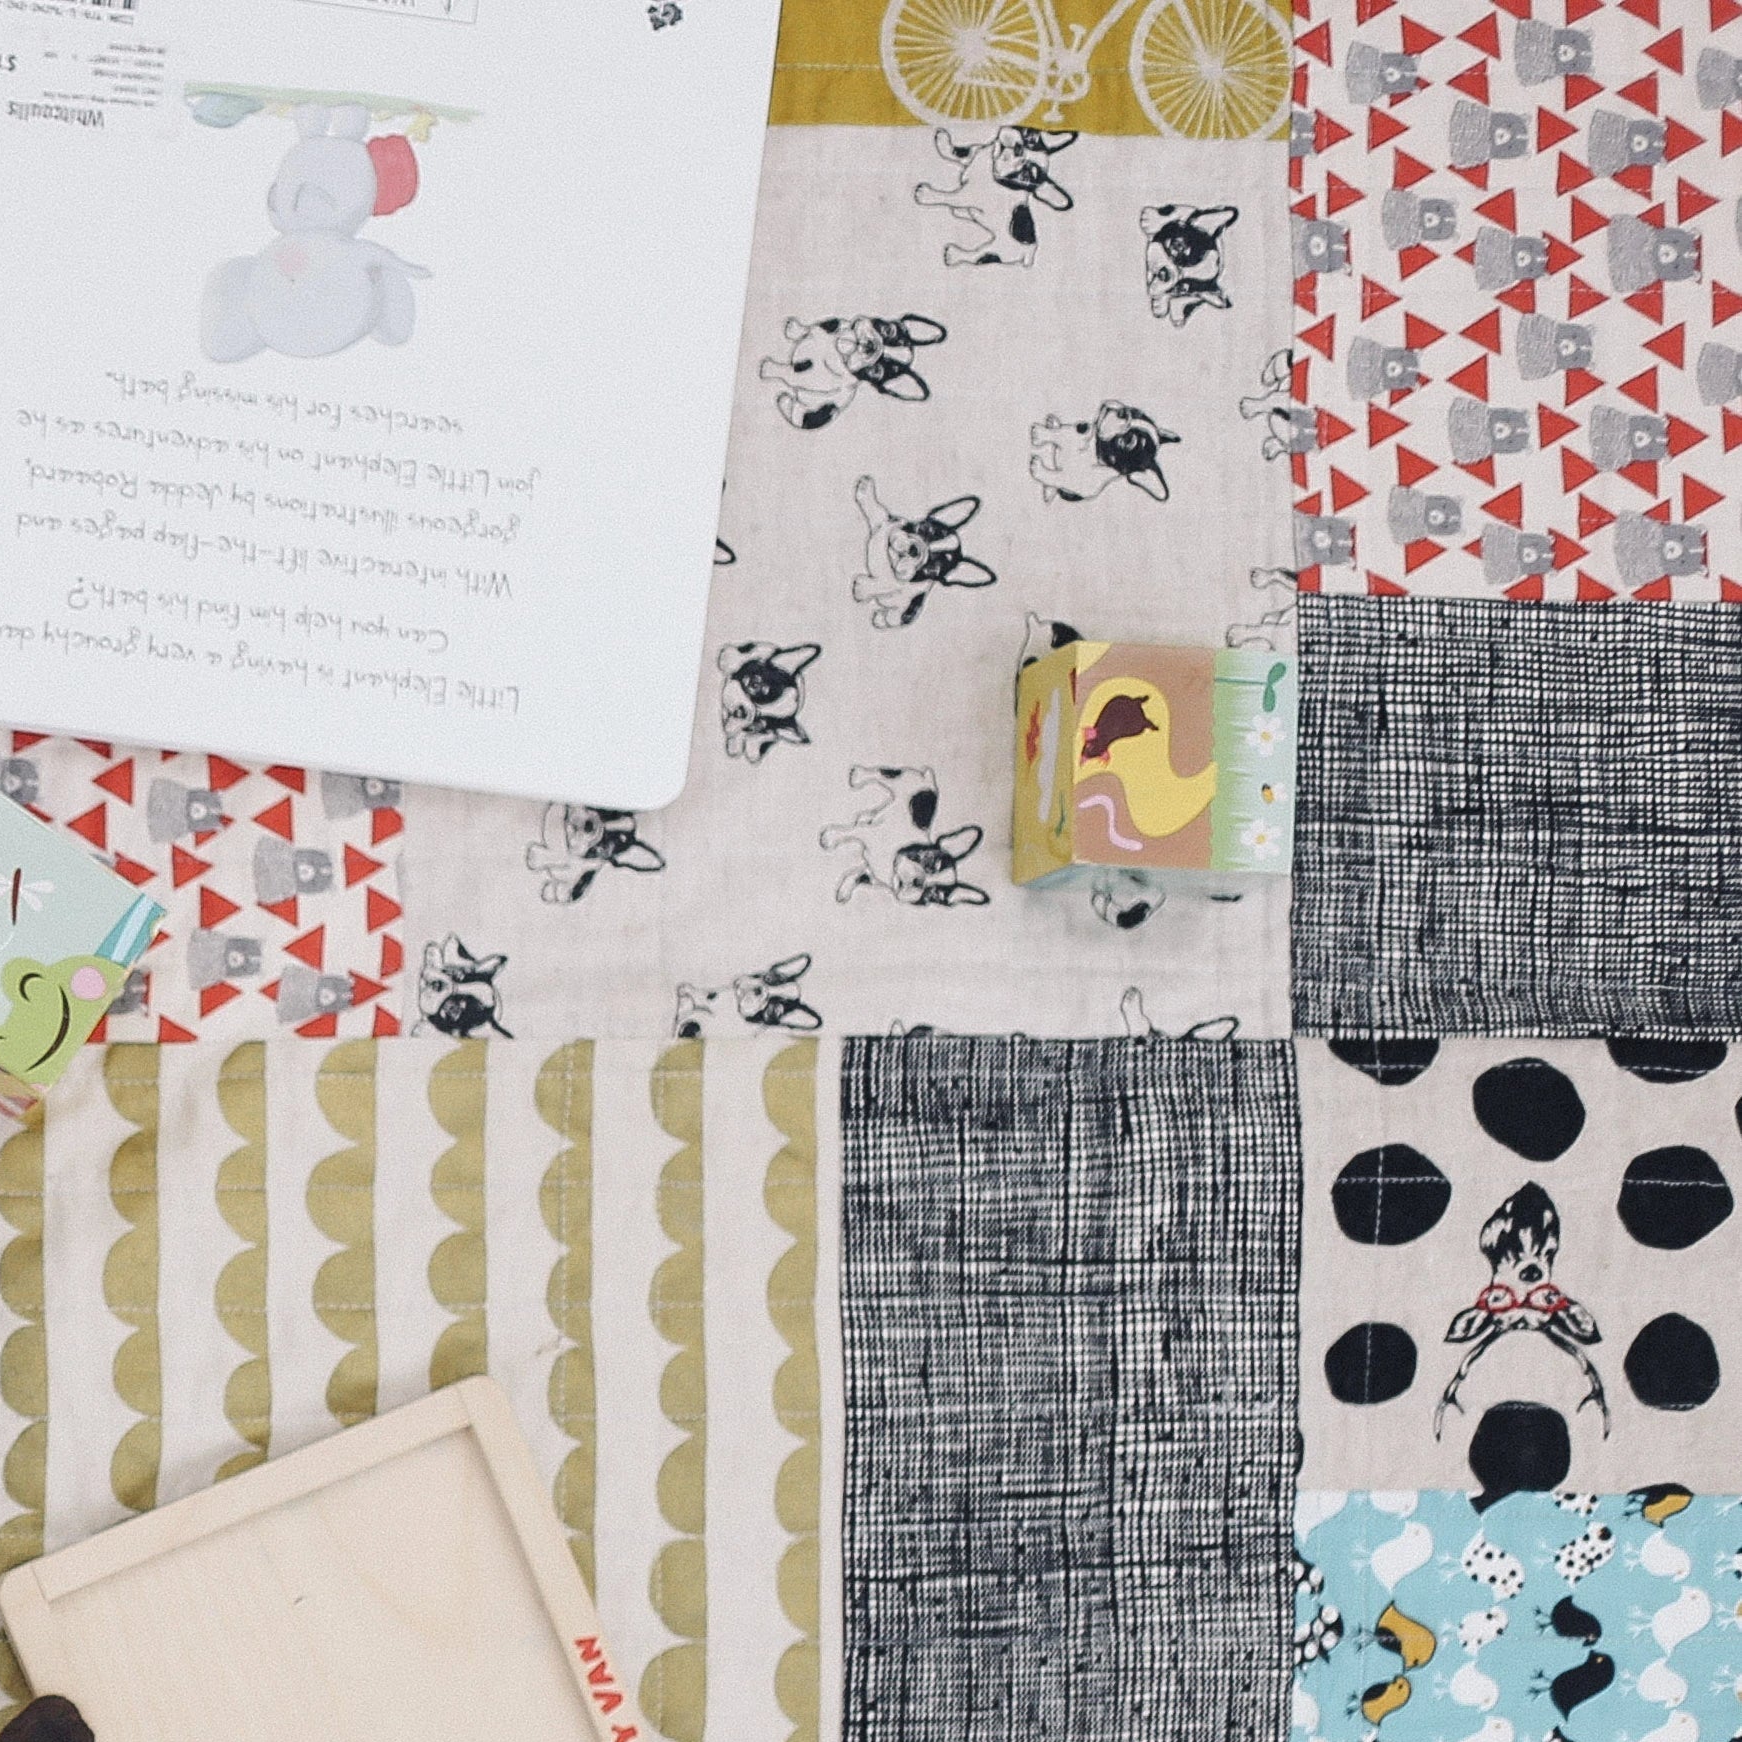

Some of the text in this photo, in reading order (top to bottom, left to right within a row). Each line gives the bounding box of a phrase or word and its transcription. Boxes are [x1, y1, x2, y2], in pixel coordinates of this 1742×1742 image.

[177, 370, 258, 406] missing
[265, 394, 299, 421] his
[305, 401, 342, 428] for
[349, 404, 464, 433] searches
[17, 408, 542, 501] join Little Elephant on his adventures as he
[230, 482, 256, 515] by
[263, 493, 399, 534] illustrations
[16, 512, 63, 537] and
[70, 508, 146, 541] pages
[406, 508, 522, 545] gorgeous
[317, 548, 448, 587] interactive
[456, 568, 512, 598] With
[66, 576, 450, 654] Can you help him find his bath?
[41, 619, 142, 658] grouchy
[147, 633, 195, 661] very
[206, 650, 223, 666] a
[230, 639, 309, 687] having
[315, 662, 334, 684] is
[341, 668, 448, 706] Elephant
[457, 680, 520, 715] Little
[574, 1635, 625, 1714] VAN
